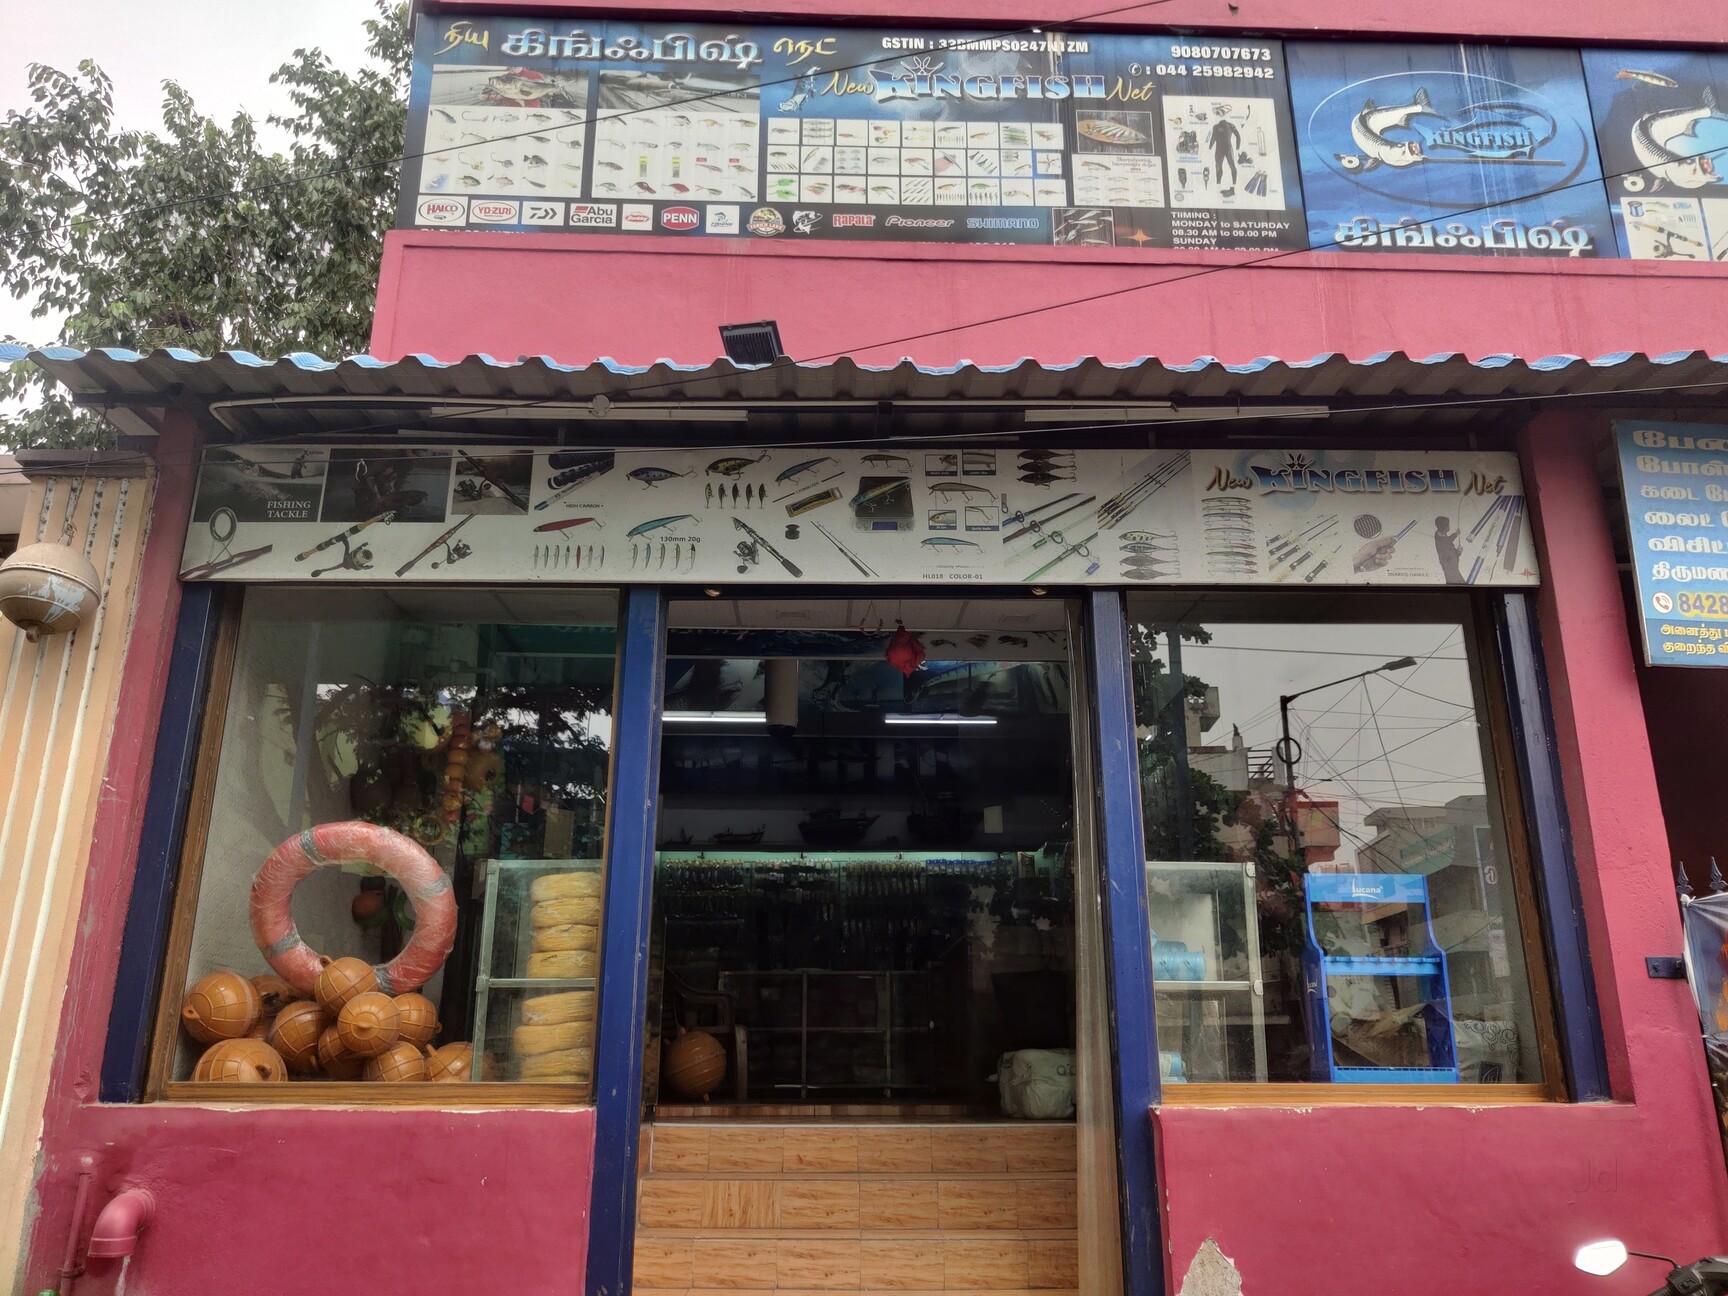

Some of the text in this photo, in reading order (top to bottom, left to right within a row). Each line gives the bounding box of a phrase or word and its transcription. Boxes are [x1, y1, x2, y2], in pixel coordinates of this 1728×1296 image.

[882, 37, 925, 50] GSTIN
[1170, 45, 1272, 61] 9080707673
[1156, 64, 1188, 76] 044
[1192, 65, 1275, 79] 25982942
[820, 65, 1157, 104] New KINGFISH Net
[426, 203, 459, 215] HALCO
[478, 206, 512, 215] YO-ZURI
[588, 205, 614, 216] Abu
[570, 214, 614, 225] Garcia
[663, 213, 697, 224] PENN
[885, 215, 955, 228] Pioneer
[966, 217, 1040, 229] SHIMANO
[1171, 220, 1218, 228] MONDAY
[1233, 221, 1290, 230] SATURDAY
[1172, 229, 1199, 237] 08.30
[1201, 229, 1218, 237] AM
[1232, 230, 1259, 238] 09.00
[1172, 237, 1217, 245] SUNDAY
[1205, 462, 1509, 497] New KINGFISH Net
[1640, 485, 1700, 501] கடை
[267, 500, 312, 510] FISHING
[267, 510, 309, 519] TACKLE
[1351, 876, 1383, 895] Lucana
